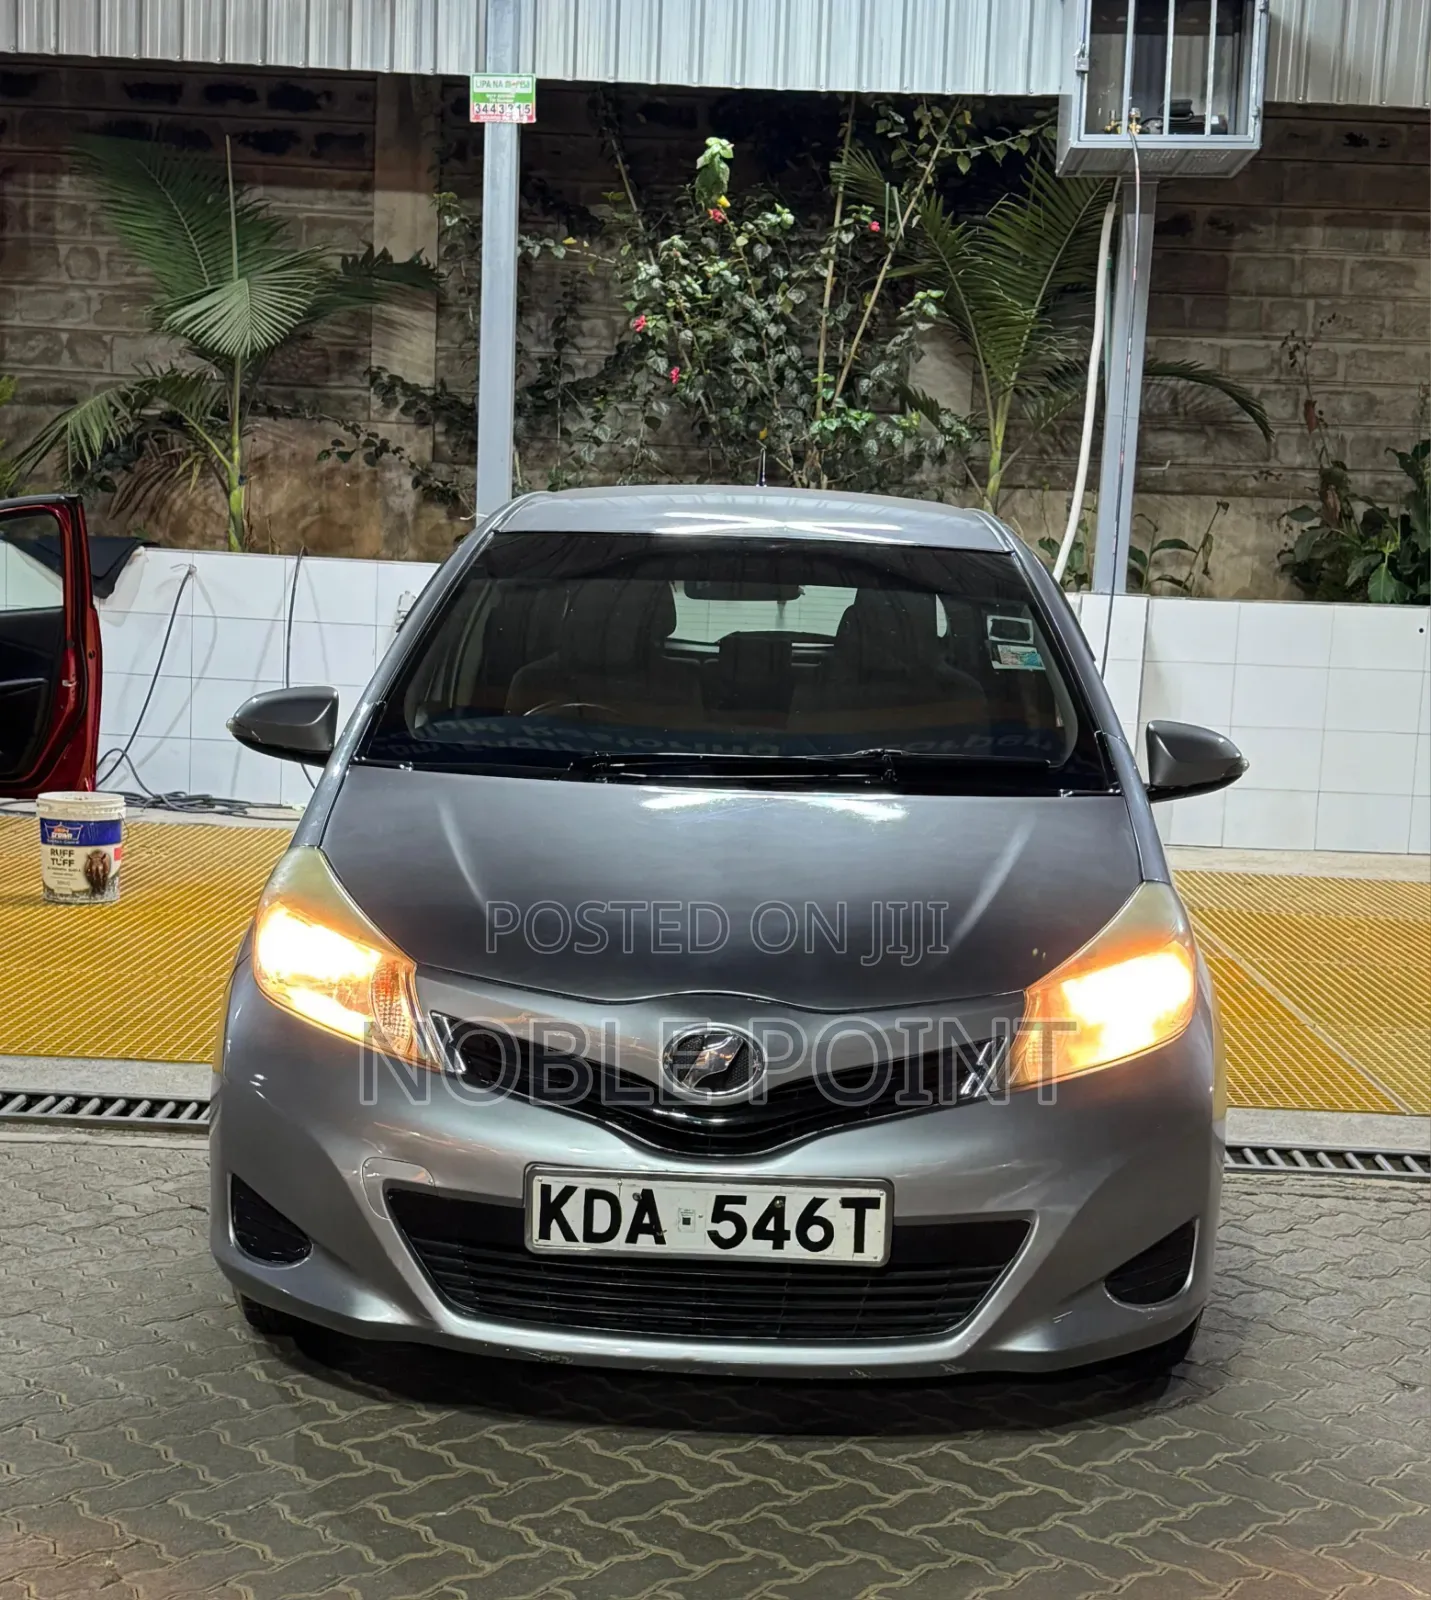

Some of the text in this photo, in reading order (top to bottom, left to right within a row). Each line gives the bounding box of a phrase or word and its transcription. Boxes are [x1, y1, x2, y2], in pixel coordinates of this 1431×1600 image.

[475, 80, 492, 88] LIPA
[493, 80, 503, 88] NA
[50, 848, 75, 858] RUFF
[50, 857, 75, 867] TUFF
[538, 1184, 882, 1254] KDA 546T
